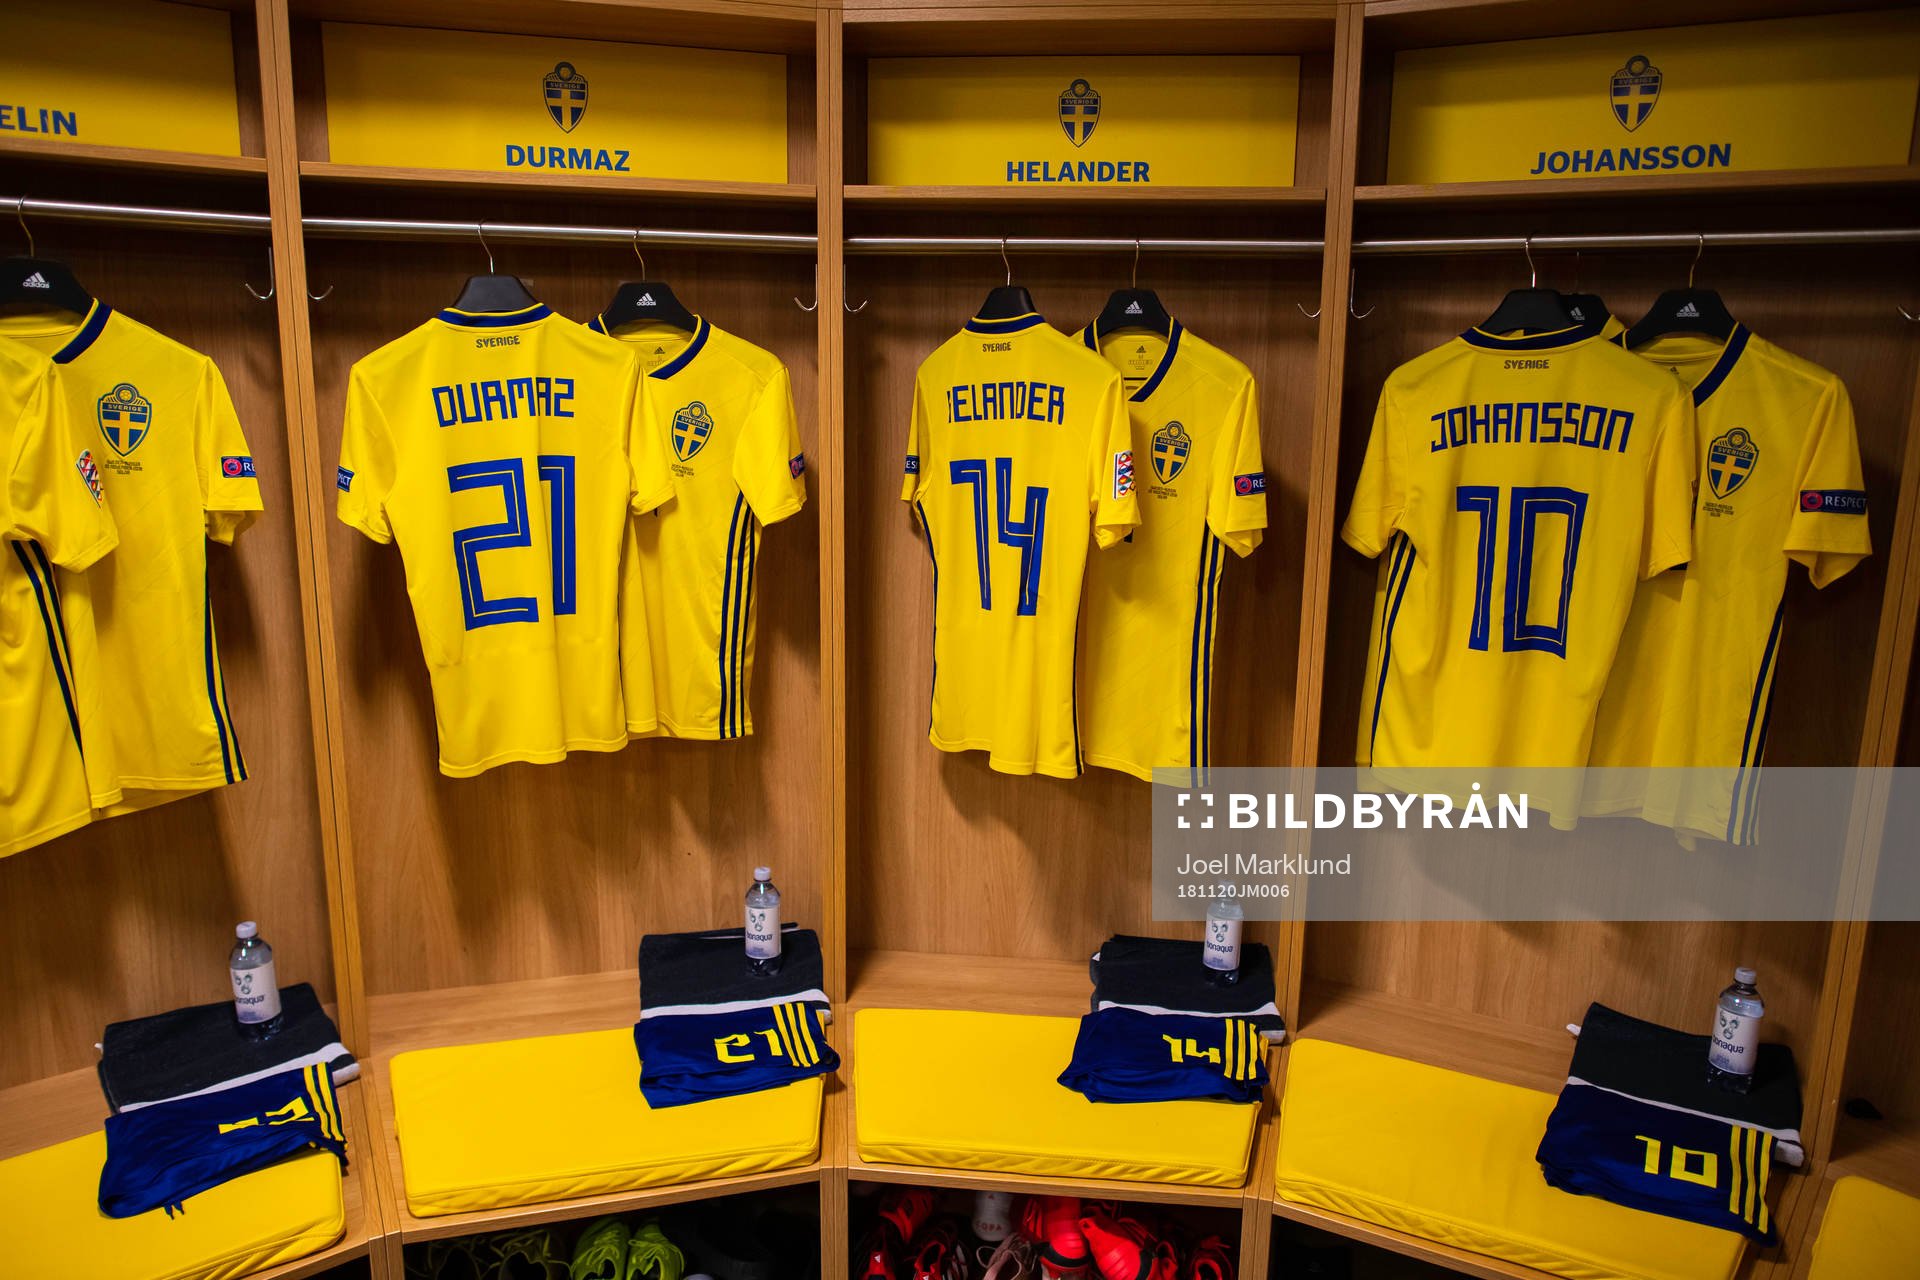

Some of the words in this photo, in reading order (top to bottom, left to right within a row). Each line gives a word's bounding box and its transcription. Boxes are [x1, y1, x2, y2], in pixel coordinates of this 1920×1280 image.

[0, 104, 78, 136] ELIN
[506, 144, 630, 172] DURMAZ
[1530, 143, 1732, 175] JOHANSSON
[1006, 161, 1150, 182] HELANDER
[22, 281, 50, 289] adidas
[476, 335, 521, 349] SVERIGE
[982, 342, 1012, 353] SVERIGE
[1503, 359, 1550, 370] SVERIGE
[107, 403, 143, 413] SVERIGE
[432, 376, 575, 428] DURMAZ
[680, 416, 706, 428] SVERIGE
[1431, 402, 1635, 453] JOHANSSON
[1159, 438, 1185, 448] SVERIGE
[1717, 446, 1750, 458] SVERIGE
[1824, 496, 1867, 509] RESPECT
[446, 455, 577, 632] 21
[949, 457, 1049, 616] 14
[1455, 485, 1589, 660] 10
[1162, 1034, 1221, 1065] 14
[1635, 1134, 1718, 1189] 10
